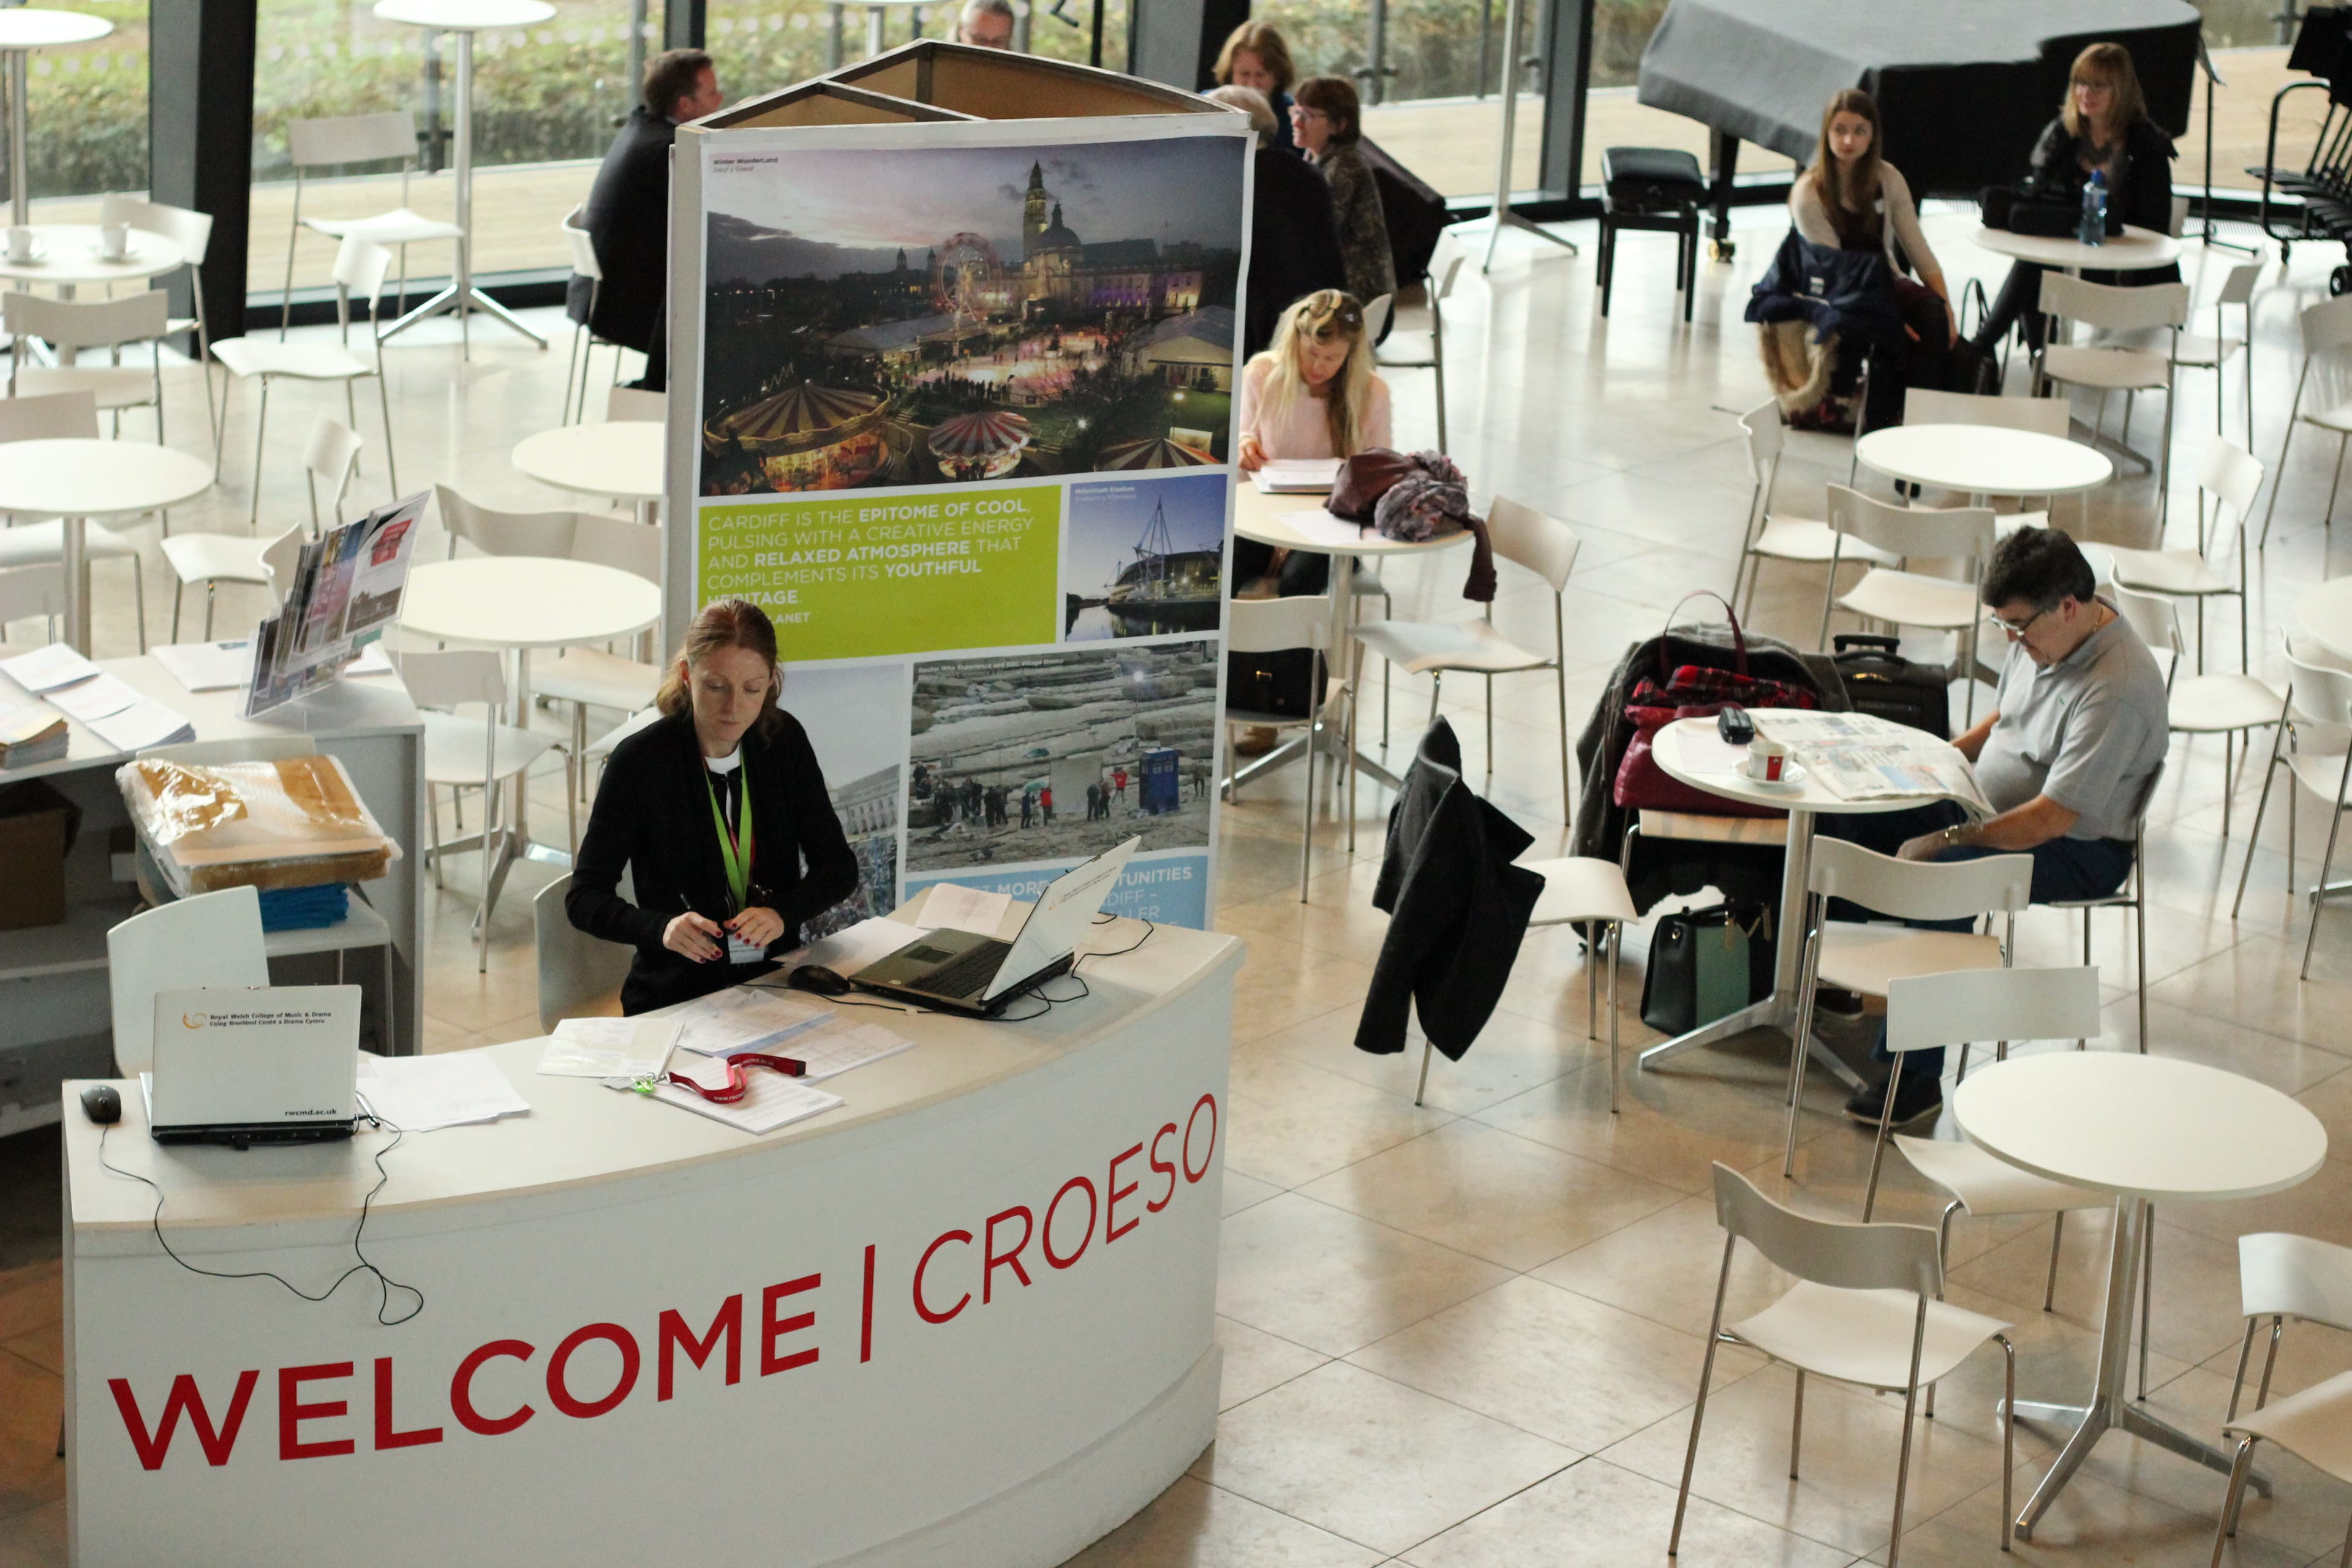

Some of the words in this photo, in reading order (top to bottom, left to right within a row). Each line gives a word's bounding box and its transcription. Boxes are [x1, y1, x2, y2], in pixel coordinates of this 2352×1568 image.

[709, 513, 790, 531] CARDIFF
[796, 512, 812, 526] IS
[819, 510, 853, 524] THE
[859, 504, 939, 522] EPITOME
[944, 502, 970, 516] OF
[709, 532, 788, 550] PULSING
[794, 530, 842, 545] WITH
[848, 528, 860, 541] A
[867, 522, 956, 541] CREATIVE
[961, 517, 1035, 535] ENERGY
[707, 554, 748, 570] AND
[755, 549, 841, 567] RELAXED
[846, 540, 970, 561] ATMOSPHERE
[976, 537, 1022, 553] THAT
[707, 567, 846, 590] COMPLEMENTS
[853, 565, 878, 579] ITS
[884, 559, 982, 578] YOUTHFUL
[107, 1273, 821, 1471] WELCOME
[913, 1093, 1217, 1324] CROESO
